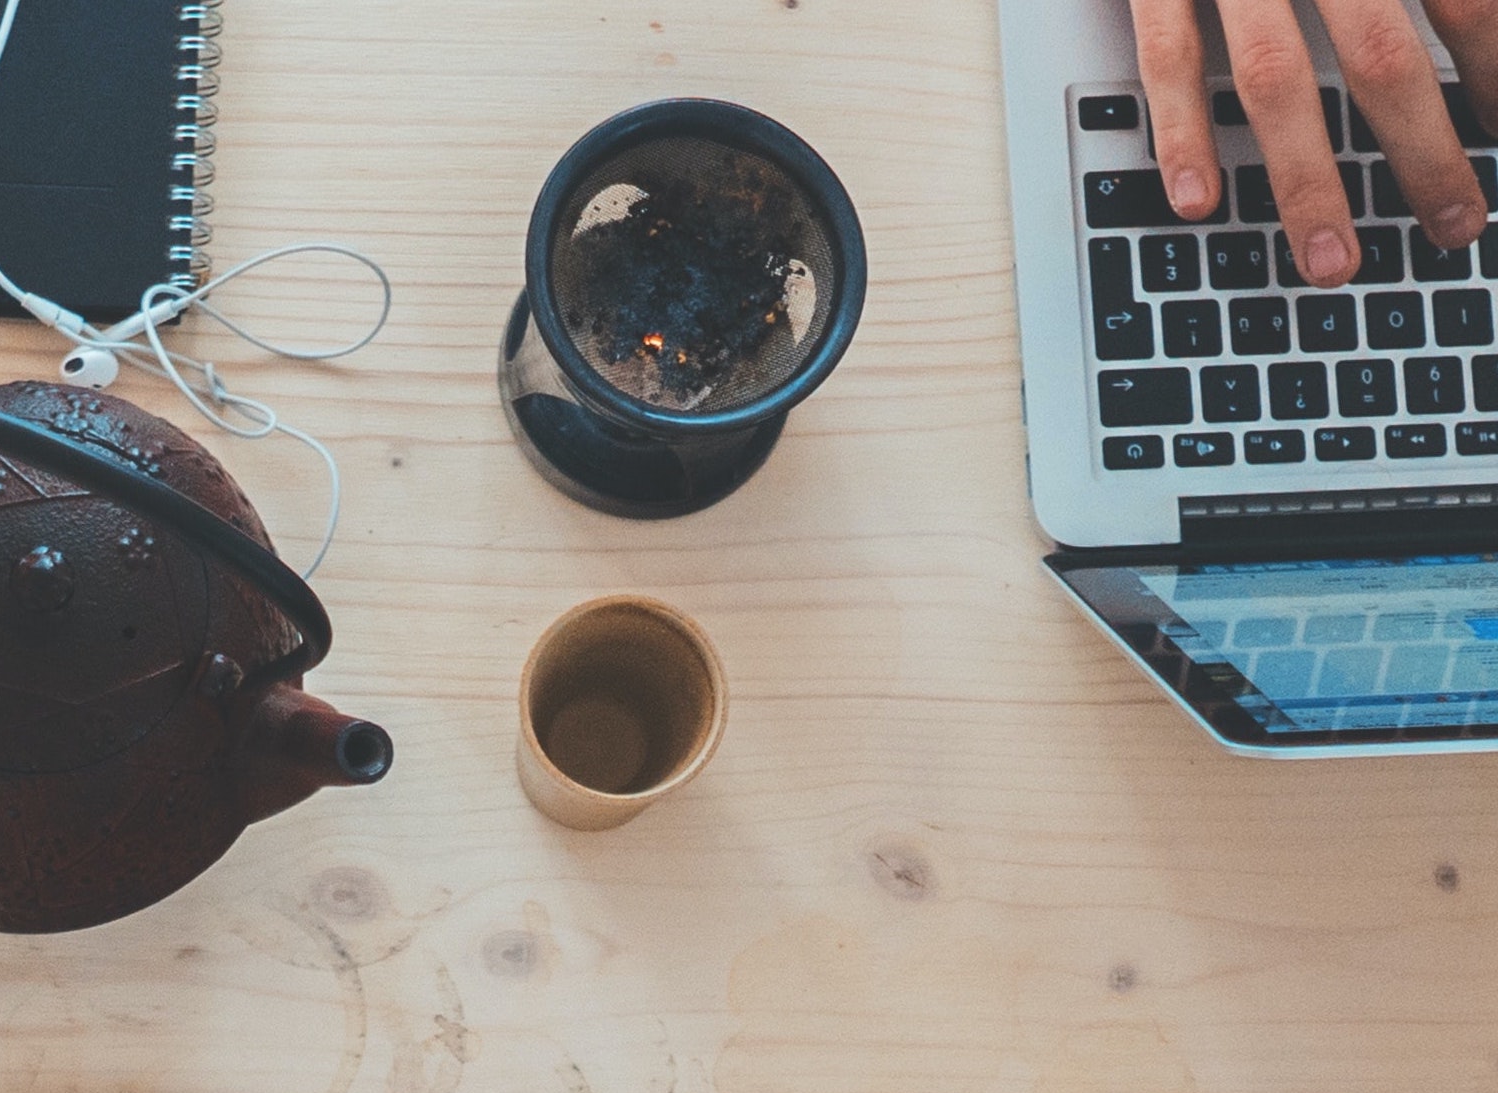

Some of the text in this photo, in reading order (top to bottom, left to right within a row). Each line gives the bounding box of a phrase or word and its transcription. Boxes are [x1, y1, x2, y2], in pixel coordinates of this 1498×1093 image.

[1370, 245, 1380, 261] L
[1321, 313, 1336, 332] P
[1387, 310, 1405, 329] O
[1428, 365, 1442, 382] 9
